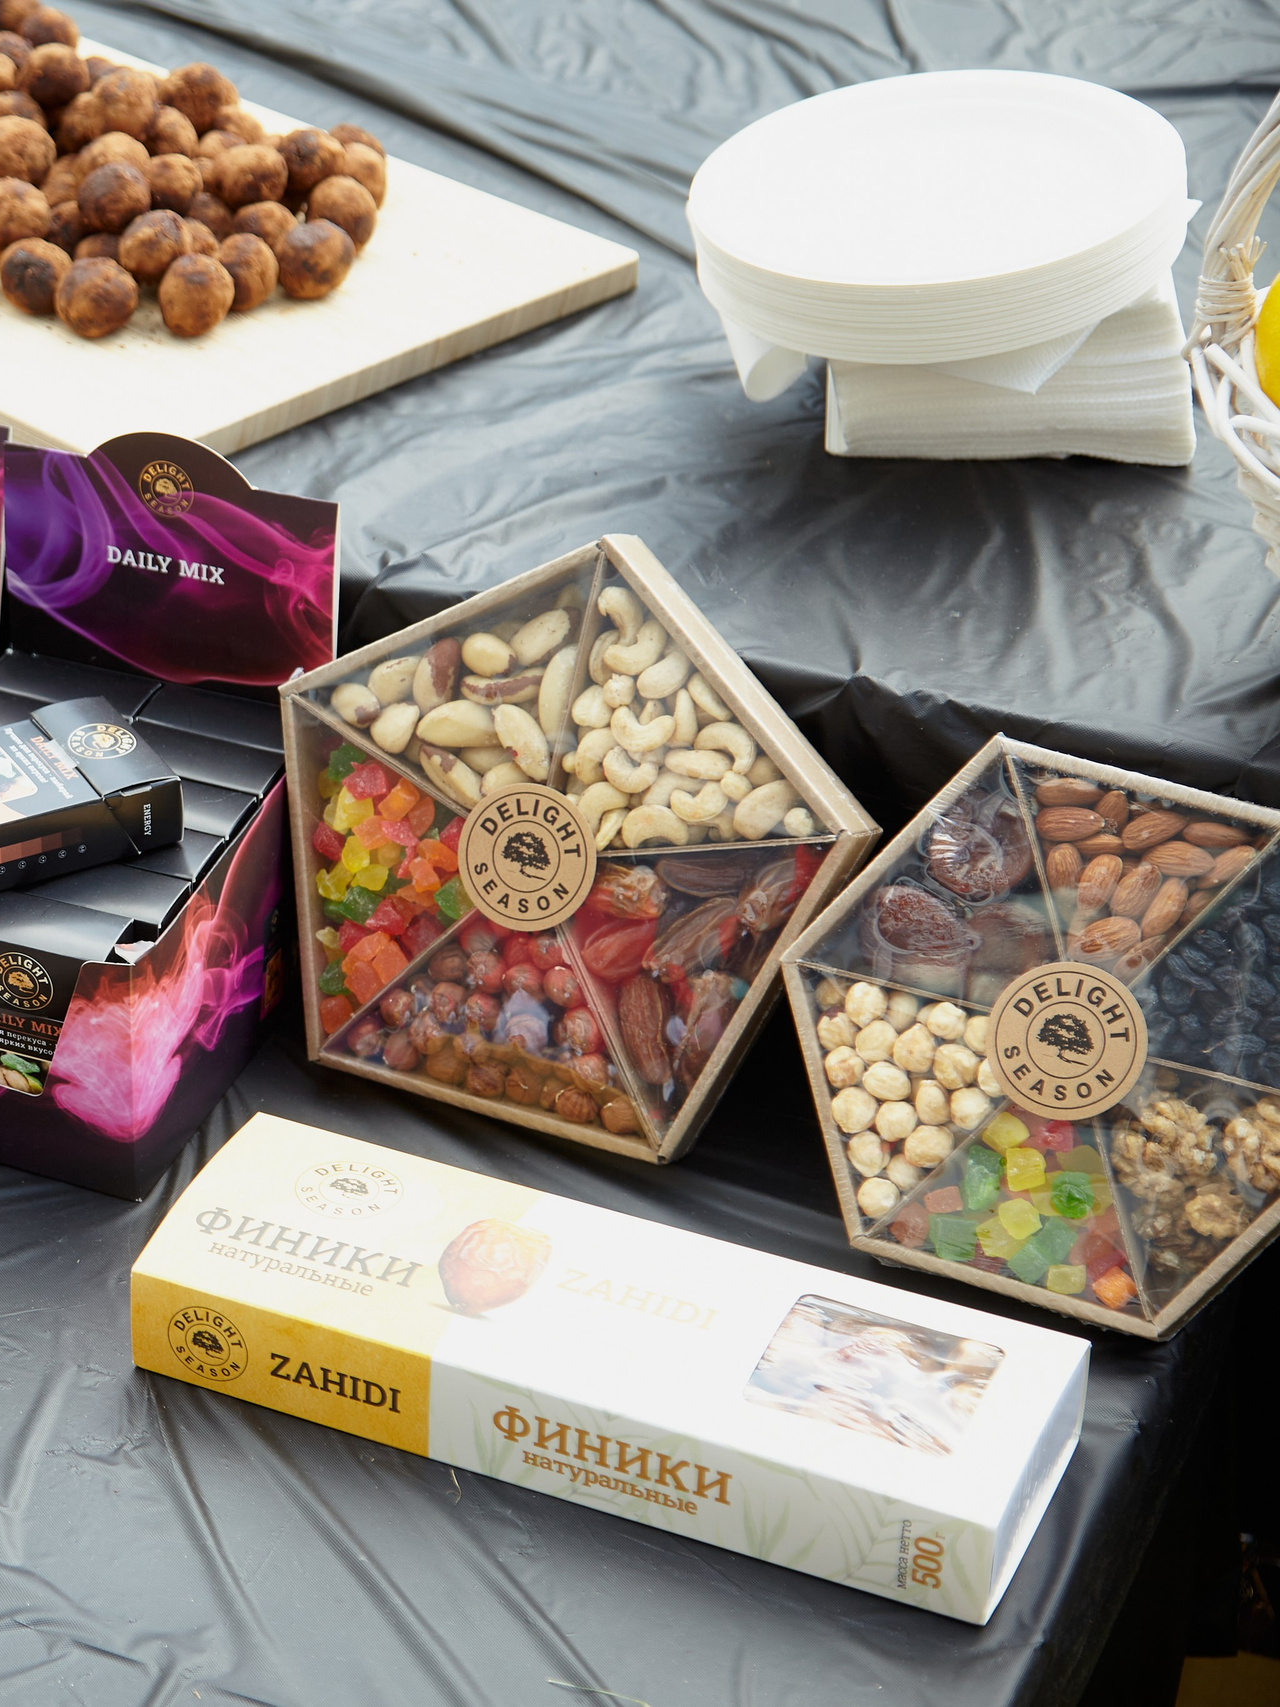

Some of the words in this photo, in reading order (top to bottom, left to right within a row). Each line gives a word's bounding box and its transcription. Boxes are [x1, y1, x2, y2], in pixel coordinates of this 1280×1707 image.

[143, 463, 191, 490] DELIGHT
[144, 492, 189, 515] SEASON
[107, 545, 172, 574] DAILY
[178, 559, 225, 585] MIX
[30, 735, 56, 760] DAILY
[54, 761, 79, 780] MIX
[71, 730, 103, 758] SEASON
[97, 725, 133, 754] DELIGHT
[143, 803, 152, 836] ENERGY
[480, 798, 581, 858] DELIGHT
[474, 862, 570, 914] SEASON
[30, 1020, 62, 1037] MIX
[1013, 977, 1130, 1043] DELIGHT
[6, 1030, 47, 1046] перекуса
[27, 1044, 54, 1056] вкусо
[1004, 1045, 1116, 1101] SEASON
[314, 1162, 398, 1195] DELIGHT
[300, 1185, 381, 1217] SEASON
[195, 1206, 423, 1288] ФИНИКИ
[207, 1241, 376, 1297] натуральные
[556, 1268, 719, 1330] ZAHIDI
[173, 1310, 243, 1349] DELIGHT
[176, 1345, 241, 1377] SEASON
[270, 1352, 402, 1414] ZAHIDI
[493, 1405, 733, 1506] ФИНИКИ
[522, 1450, 698, 1516] натуральные
[900, 1519, 912, 1555] нетто
[897, 1556, 908, 1590] масса
[911, 1536, 945, 1589] 500
